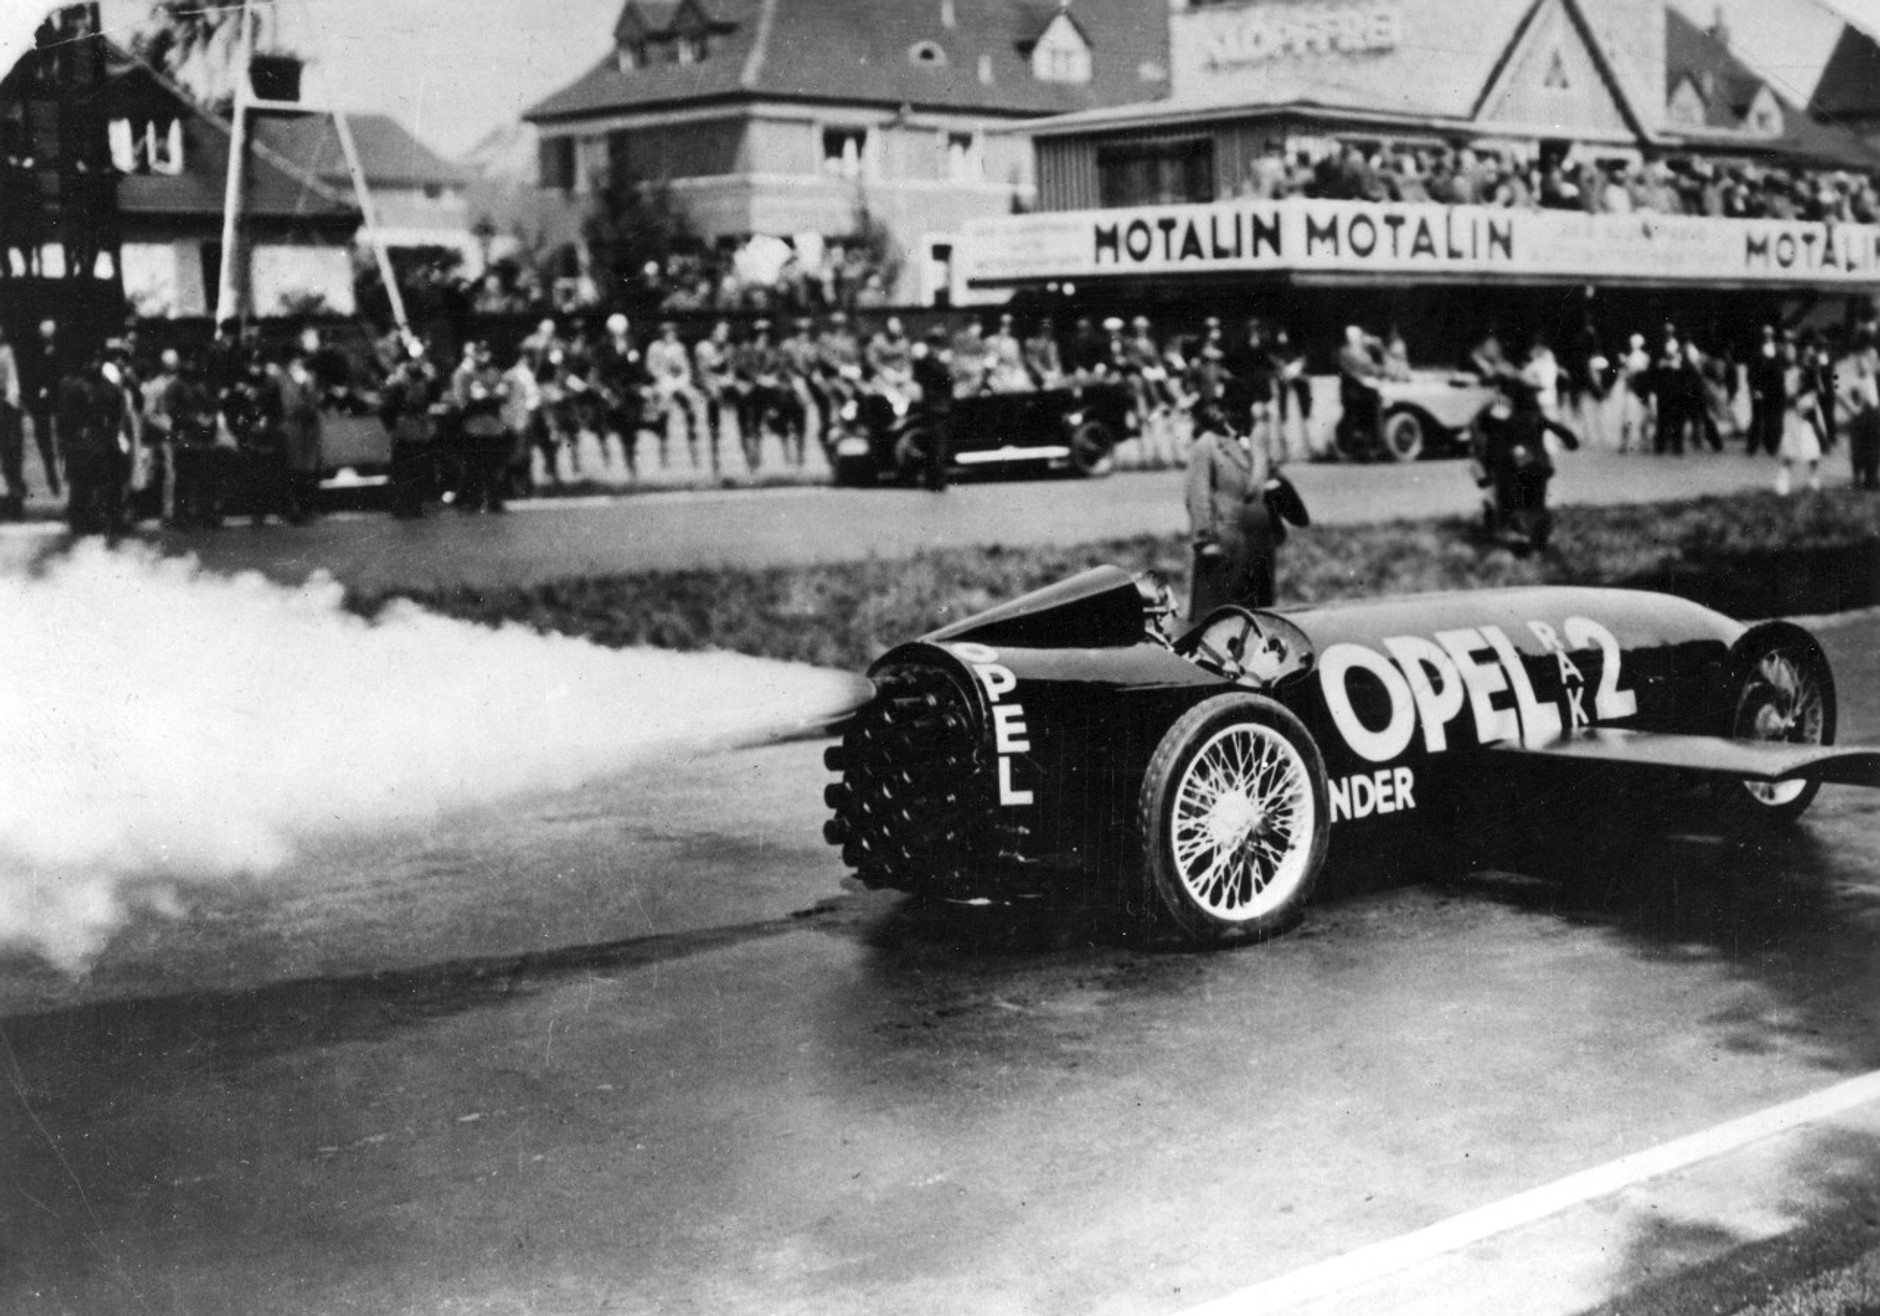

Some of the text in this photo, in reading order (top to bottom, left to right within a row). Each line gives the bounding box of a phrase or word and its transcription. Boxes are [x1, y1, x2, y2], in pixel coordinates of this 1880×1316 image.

[1094, 211, 1513, 264] MOTALIN MOTALIN
[1746, 224, 1880, 273] MOTALI
[950, 641, 1034, 806] OPEL
[1318, 616, 1638, 763] OPEL RAK 2
